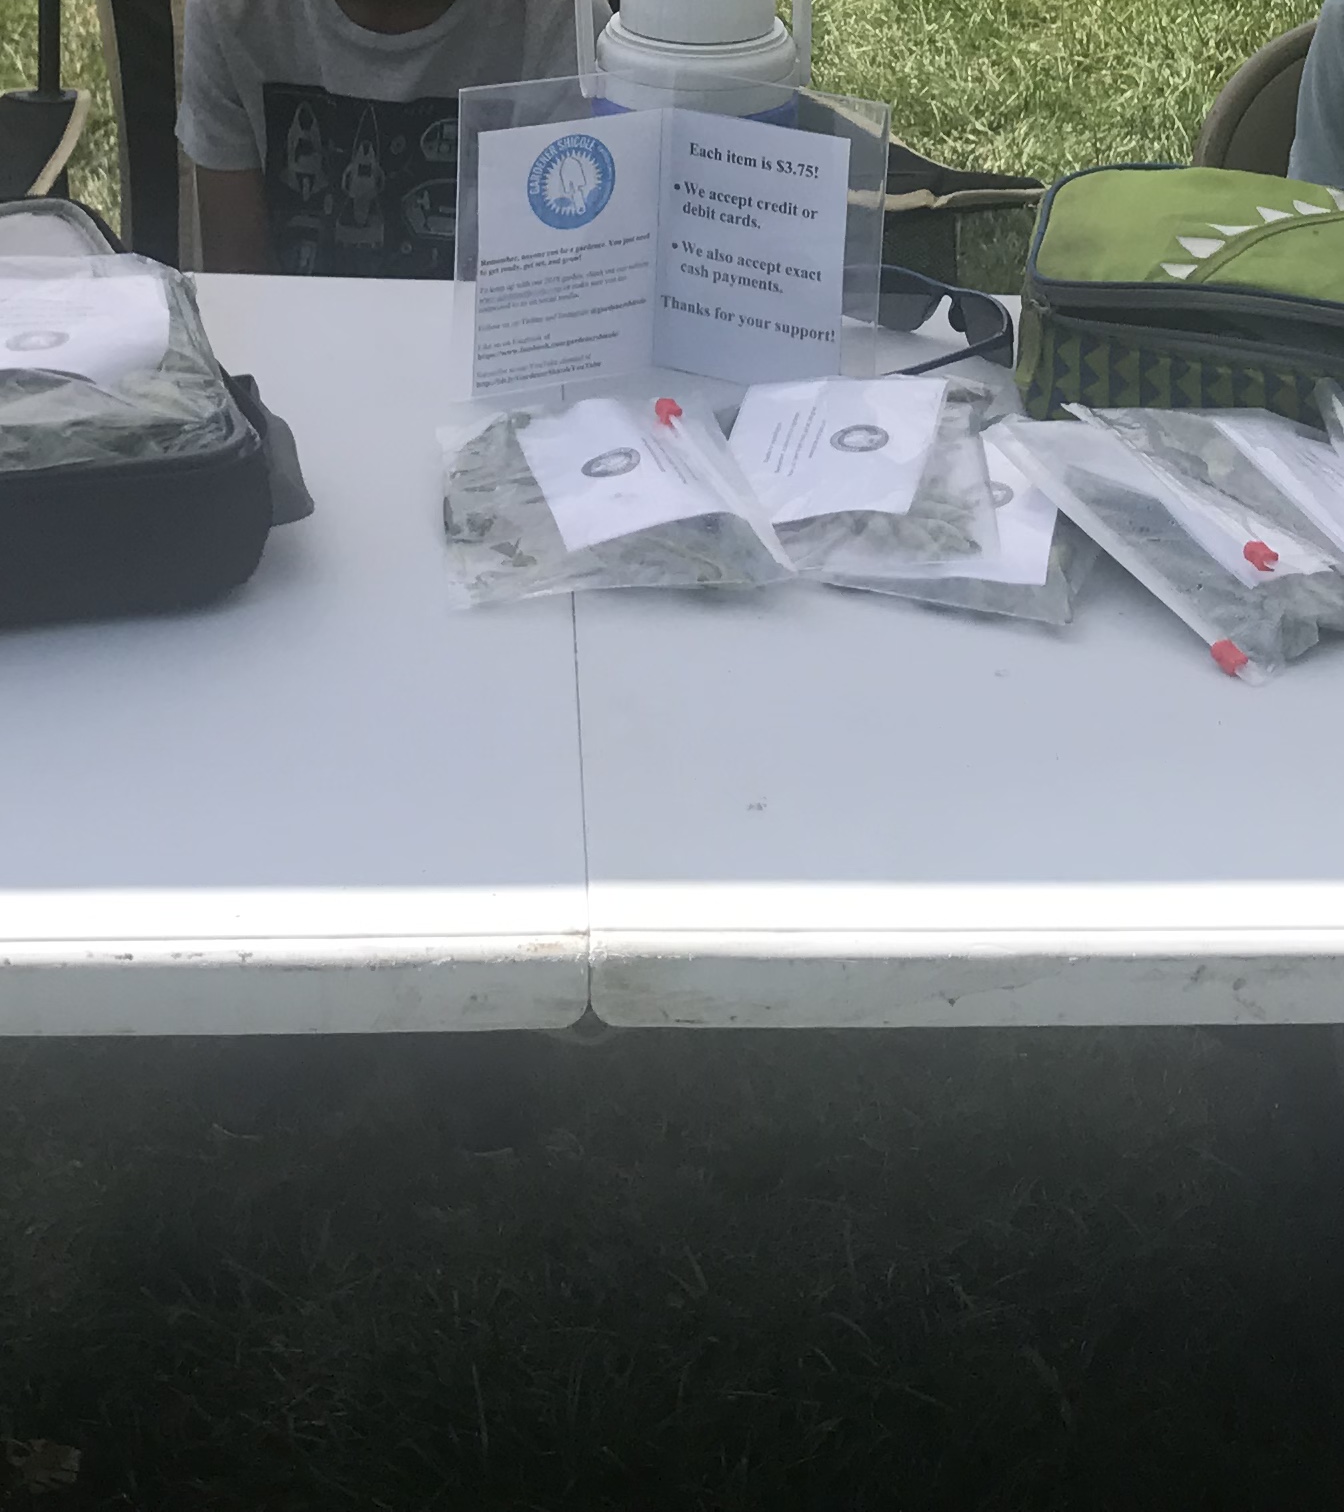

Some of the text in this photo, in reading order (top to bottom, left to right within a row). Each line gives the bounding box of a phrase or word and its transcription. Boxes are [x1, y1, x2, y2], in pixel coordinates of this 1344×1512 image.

[529, 145, 558, 195] GARDENER
[689, 142, 819, 179] Each item is $3.75!
[682, 201, 761, 229] debit cards.
[684, 181, 818, 220] We accept credit or
[680, 262, 784, 294] cash payments.
[682, 240, 822, 282] We also accept exact
[661, 294, 711, 317] Thanks
[714, 307, 735, 322] for
[738, 314, 772, 330] your
[774, 321, 835, 343] support!
